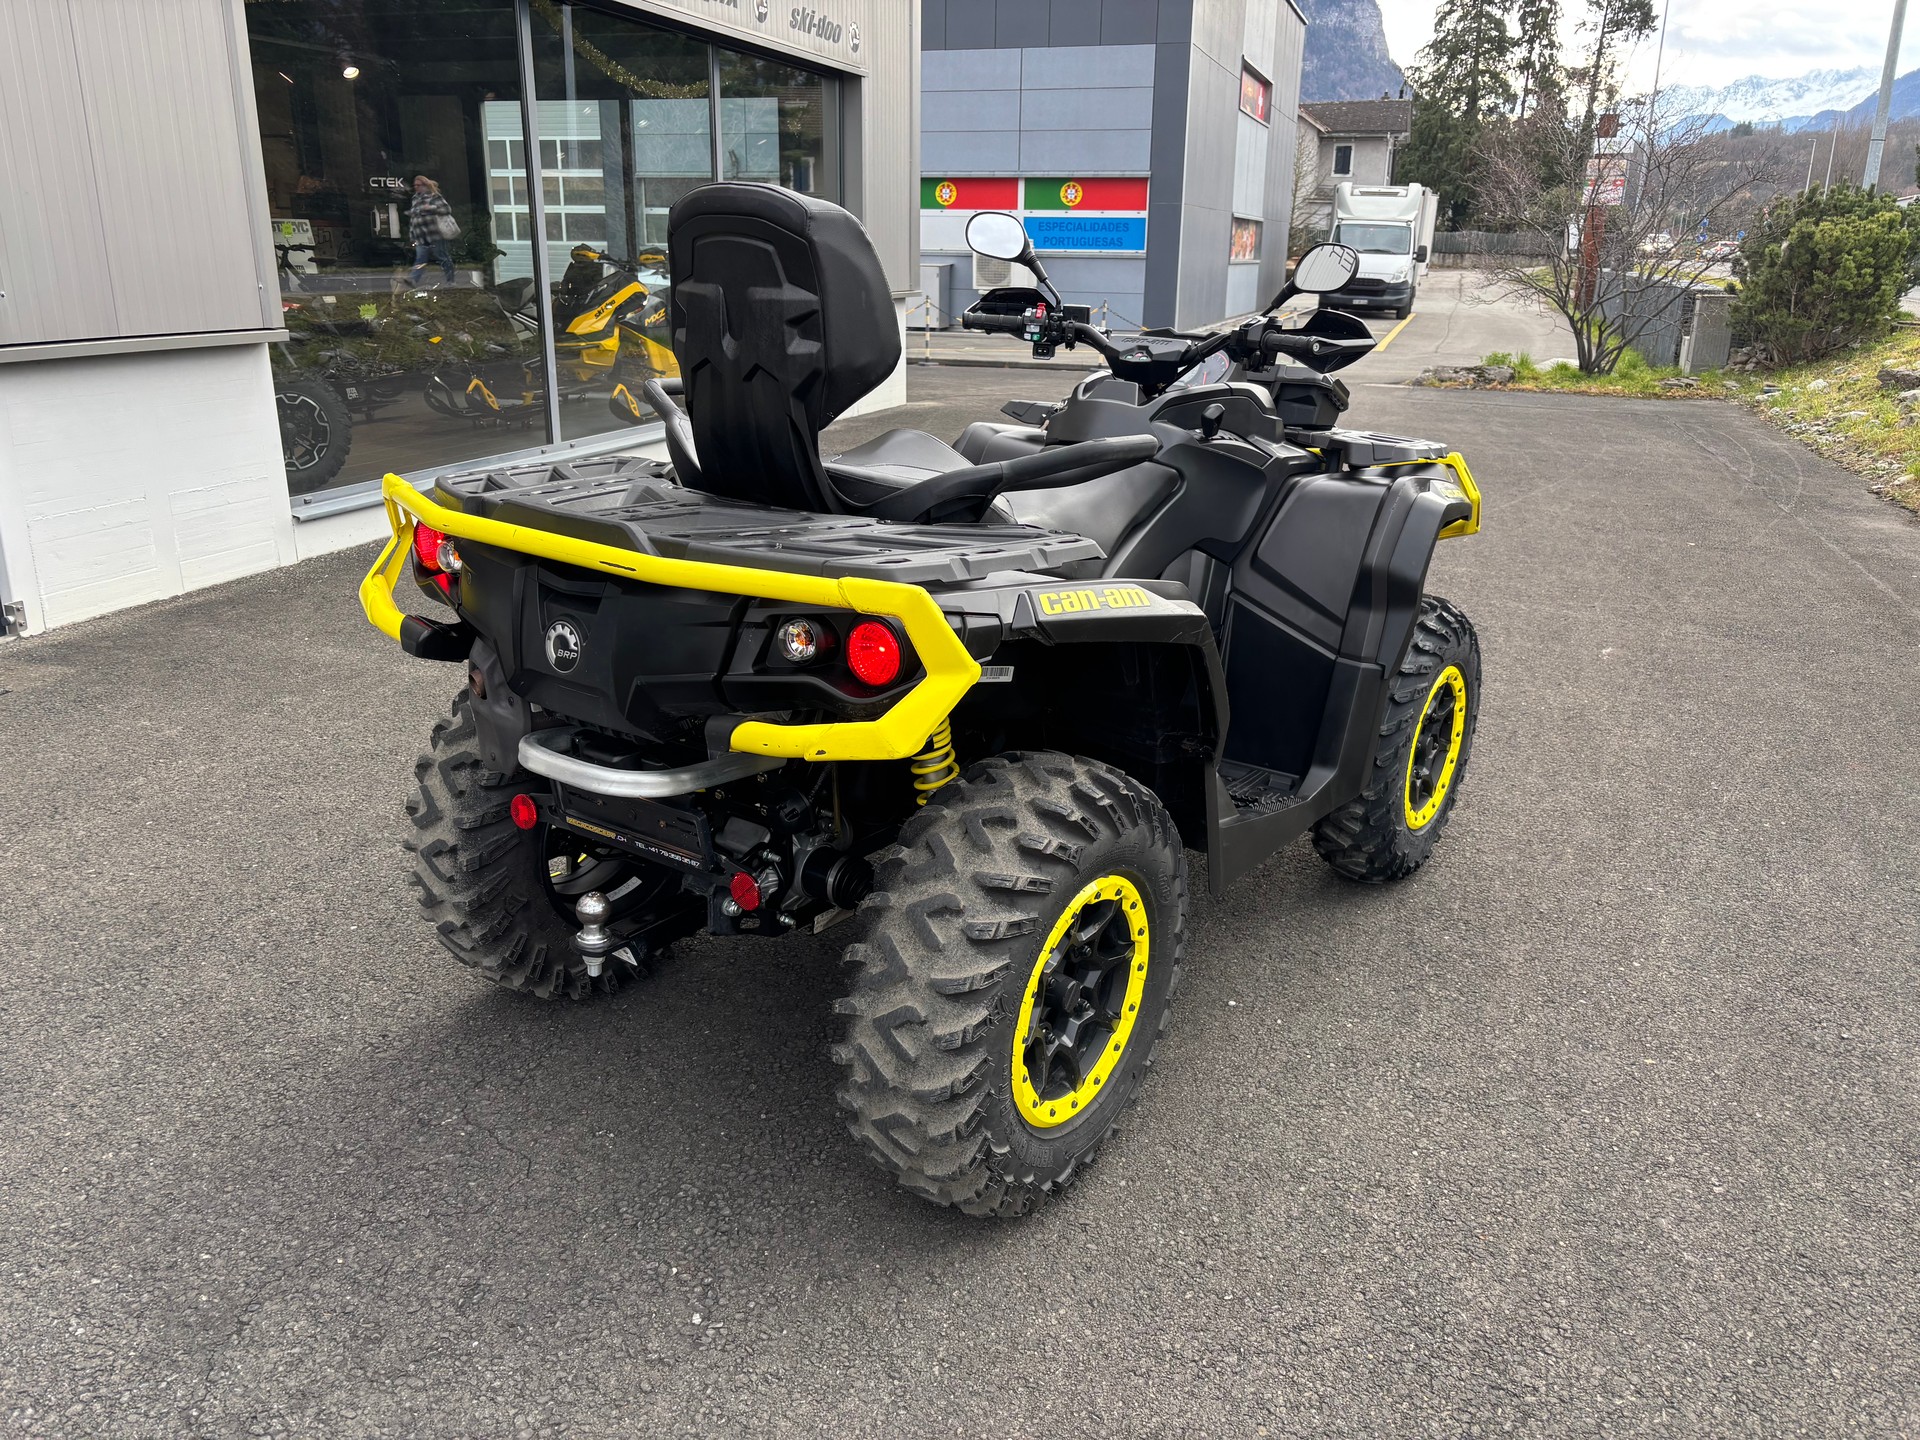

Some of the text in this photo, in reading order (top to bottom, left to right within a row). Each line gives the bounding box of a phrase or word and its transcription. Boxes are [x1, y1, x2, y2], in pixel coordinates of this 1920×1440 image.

[789, 6, 842, 44] ski-doo
[369, 177, 404, 187] CTEK
[1038, 221, 1129, 232] ESPECIALIDADES
[1043, 236, 1124, 247] PORTUGUESAS
[1038, 588, 1151, 616] can-am
[557, 648, 578, 660] BRP
